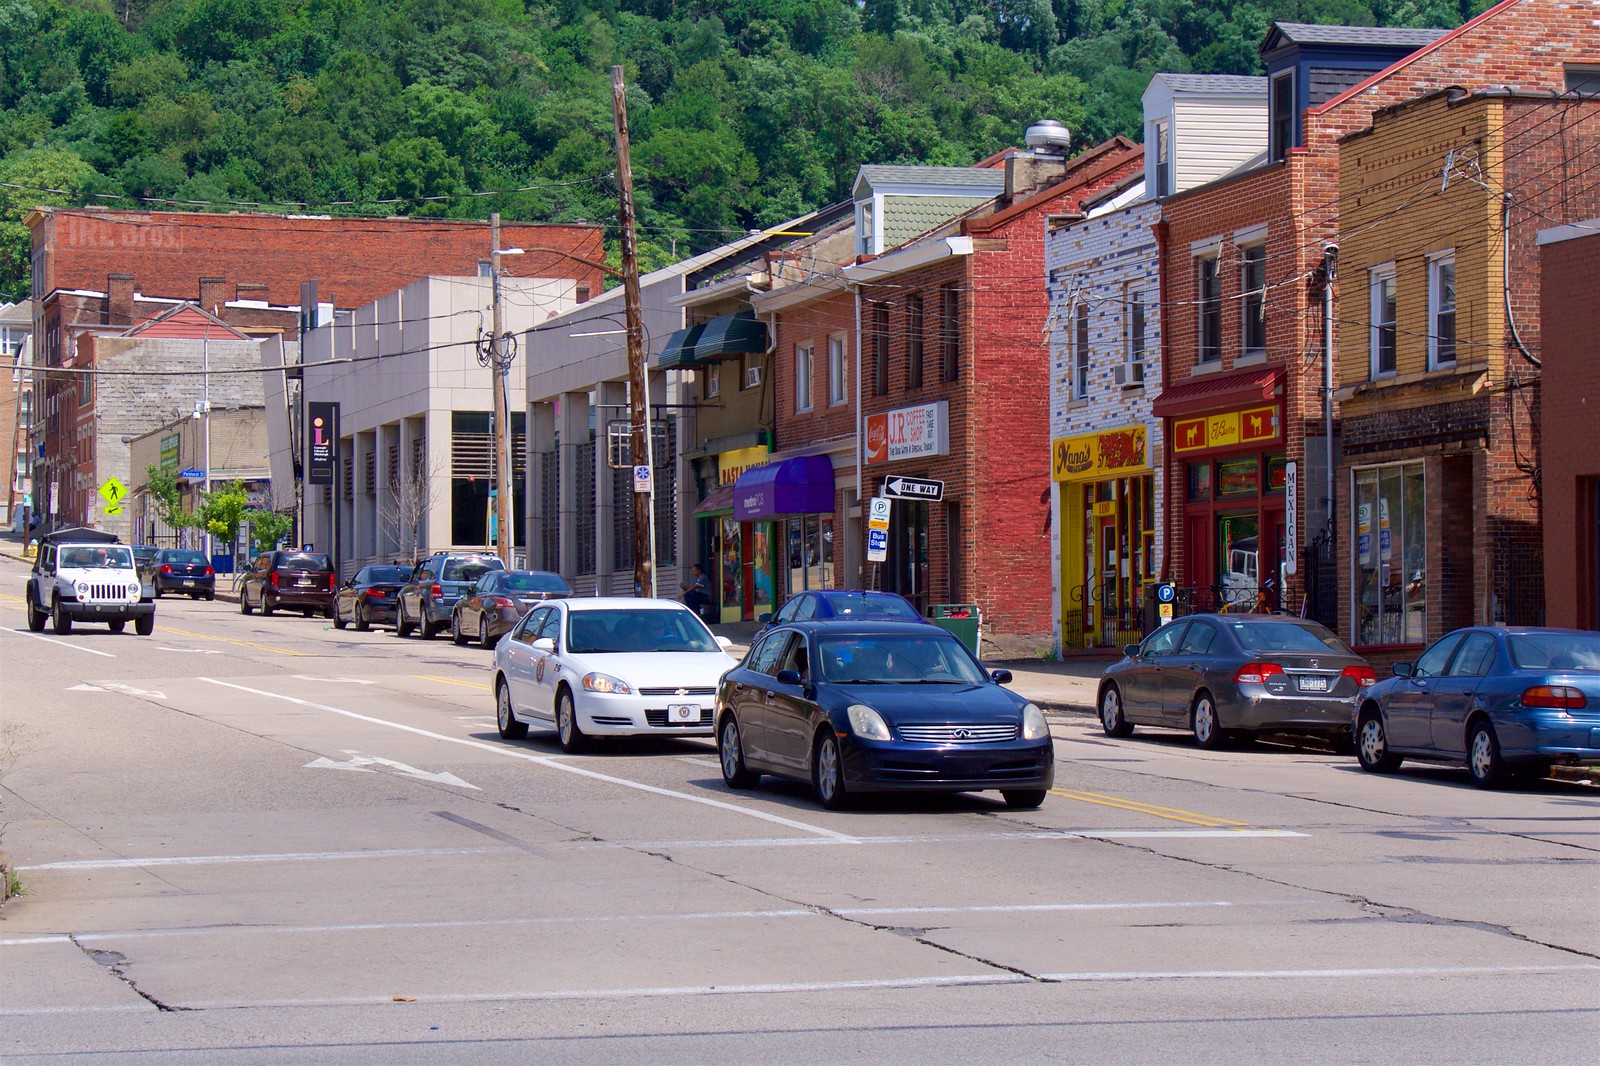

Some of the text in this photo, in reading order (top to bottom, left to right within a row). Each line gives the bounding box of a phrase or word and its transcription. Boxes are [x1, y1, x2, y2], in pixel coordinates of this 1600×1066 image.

[907, 409, 925, 425] COFFEE
[889, 412, 907, 444] J.R.
[910, 425, 922, 442] SHOP
[1057, 441, 1091, 475] Nana's
[722, 466, 743, 486] RASTA
[901, 483, 936, 494] ONE WAY
[744, 492, 764, 508] metroPCS
[1287, 472, 1295, 562] MEXICAN
[872, 532, 885, 540] Bus
[1163, 588, 1171, 599] P
[1162, 605, 1170, 613] 2
